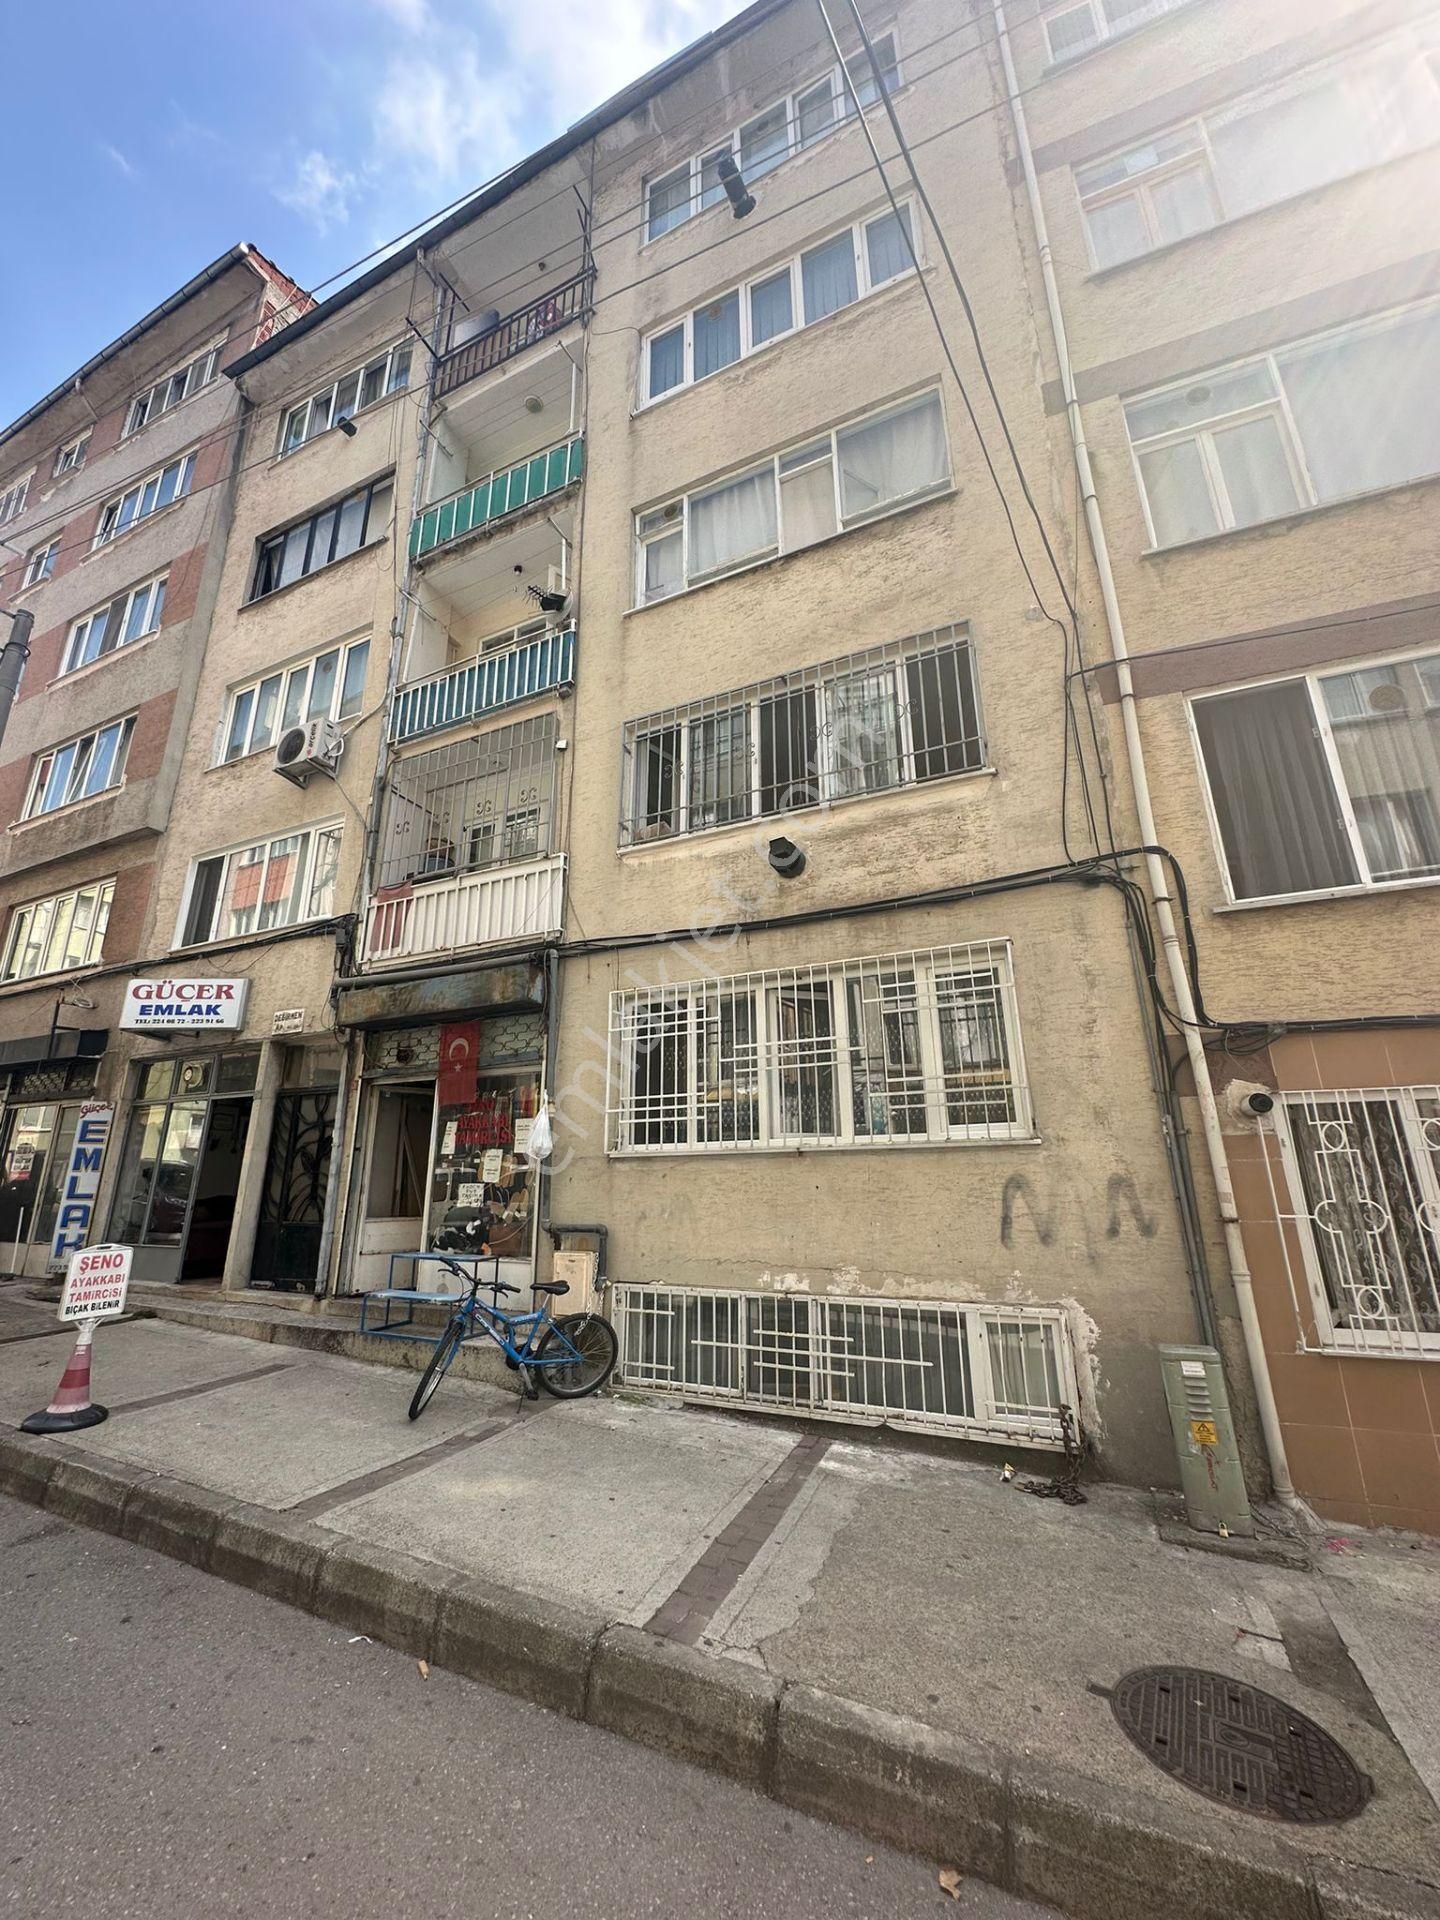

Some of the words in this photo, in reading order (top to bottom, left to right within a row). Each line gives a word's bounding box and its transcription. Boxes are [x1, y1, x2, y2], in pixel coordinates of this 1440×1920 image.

[132, 980, 235, 1002] GÜÇER
[139, 1004, 223, 1016] EMLAK
[54, 1120, 109, 1259] EMLAK
[80, 1253, 124, 1275] ŞENO
[70, 1274, 125, 1288] AYAKKABI
[65, 1304, 89, 1315] BIÇAK
